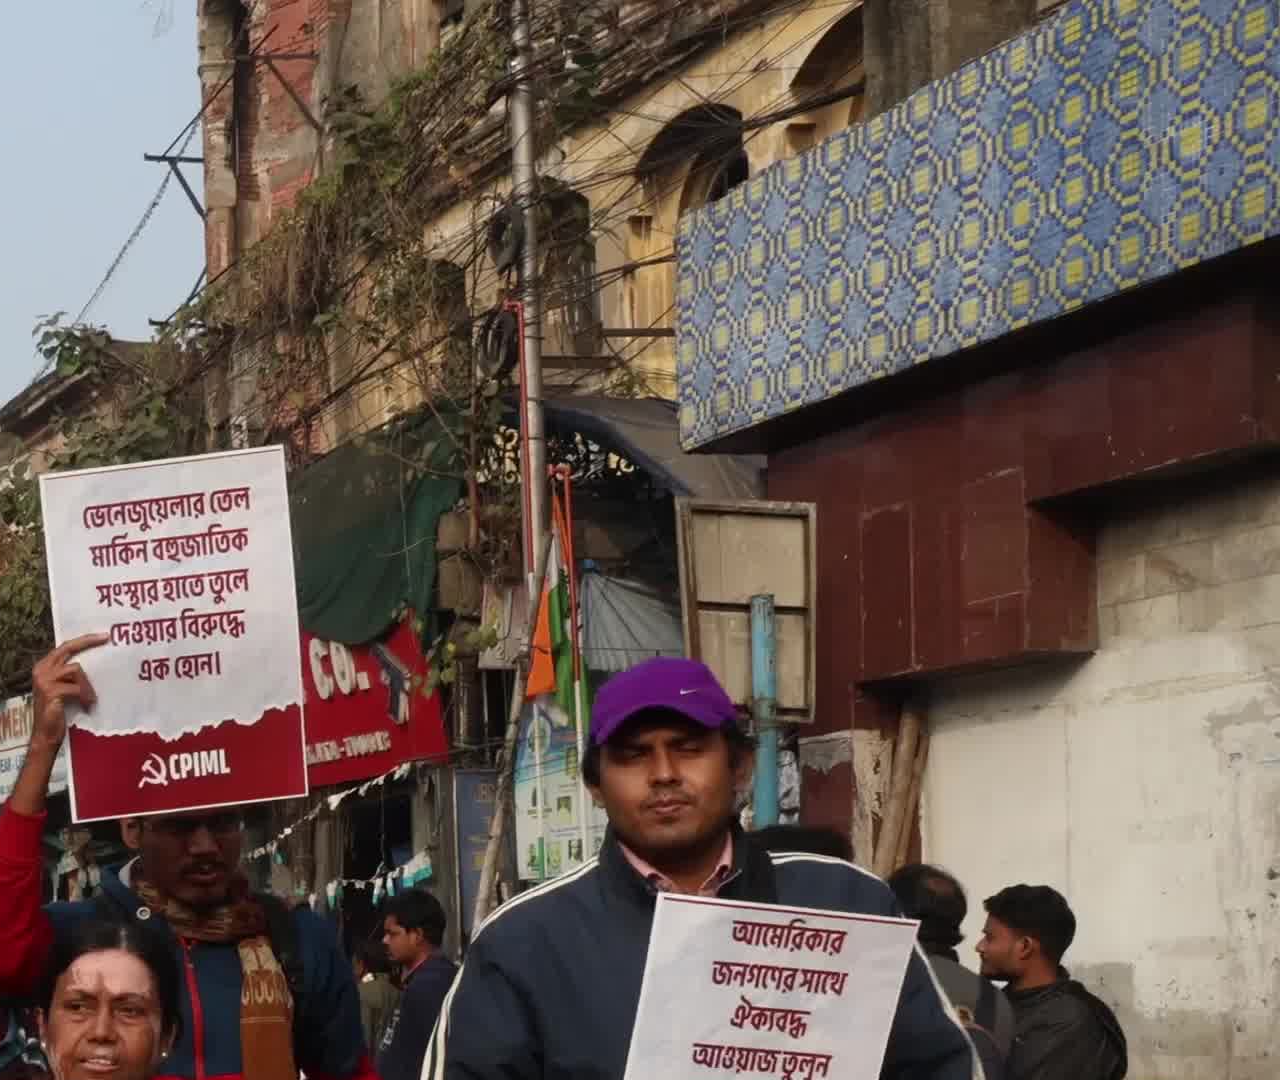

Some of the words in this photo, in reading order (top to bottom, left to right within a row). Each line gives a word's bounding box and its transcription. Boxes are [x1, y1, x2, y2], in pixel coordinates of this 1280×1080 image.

[82, 492, 206, 533] ভেনেজুয়েলার
[209, 485, 251, 518] তেল
[88, 533, 149, 570] মার্কিন
[151, 526, 249, 563] বহুজাতিক
[96, 577, 159, 612] সংস্থার
[161, 573, 205, 604] হাতে
[206, 567, 249, 607] তুলে
[109, 615, 177, 648] দেওয়ার
[179, 606, 246, 642] বিরুদ্ধে
[138, 656, 171, 683] এক
[168, 747, 231, 781] CPIML
[732, 918, 848, 957] আমেরিকার
[711, 959, 799, 993] জনগণের
[799, 968, 848, 997] সাথে
[729, 995, 811, 1040] ঐক্যবদ্ধ
[692, 1042, 779, 1075] আওয়াজ
